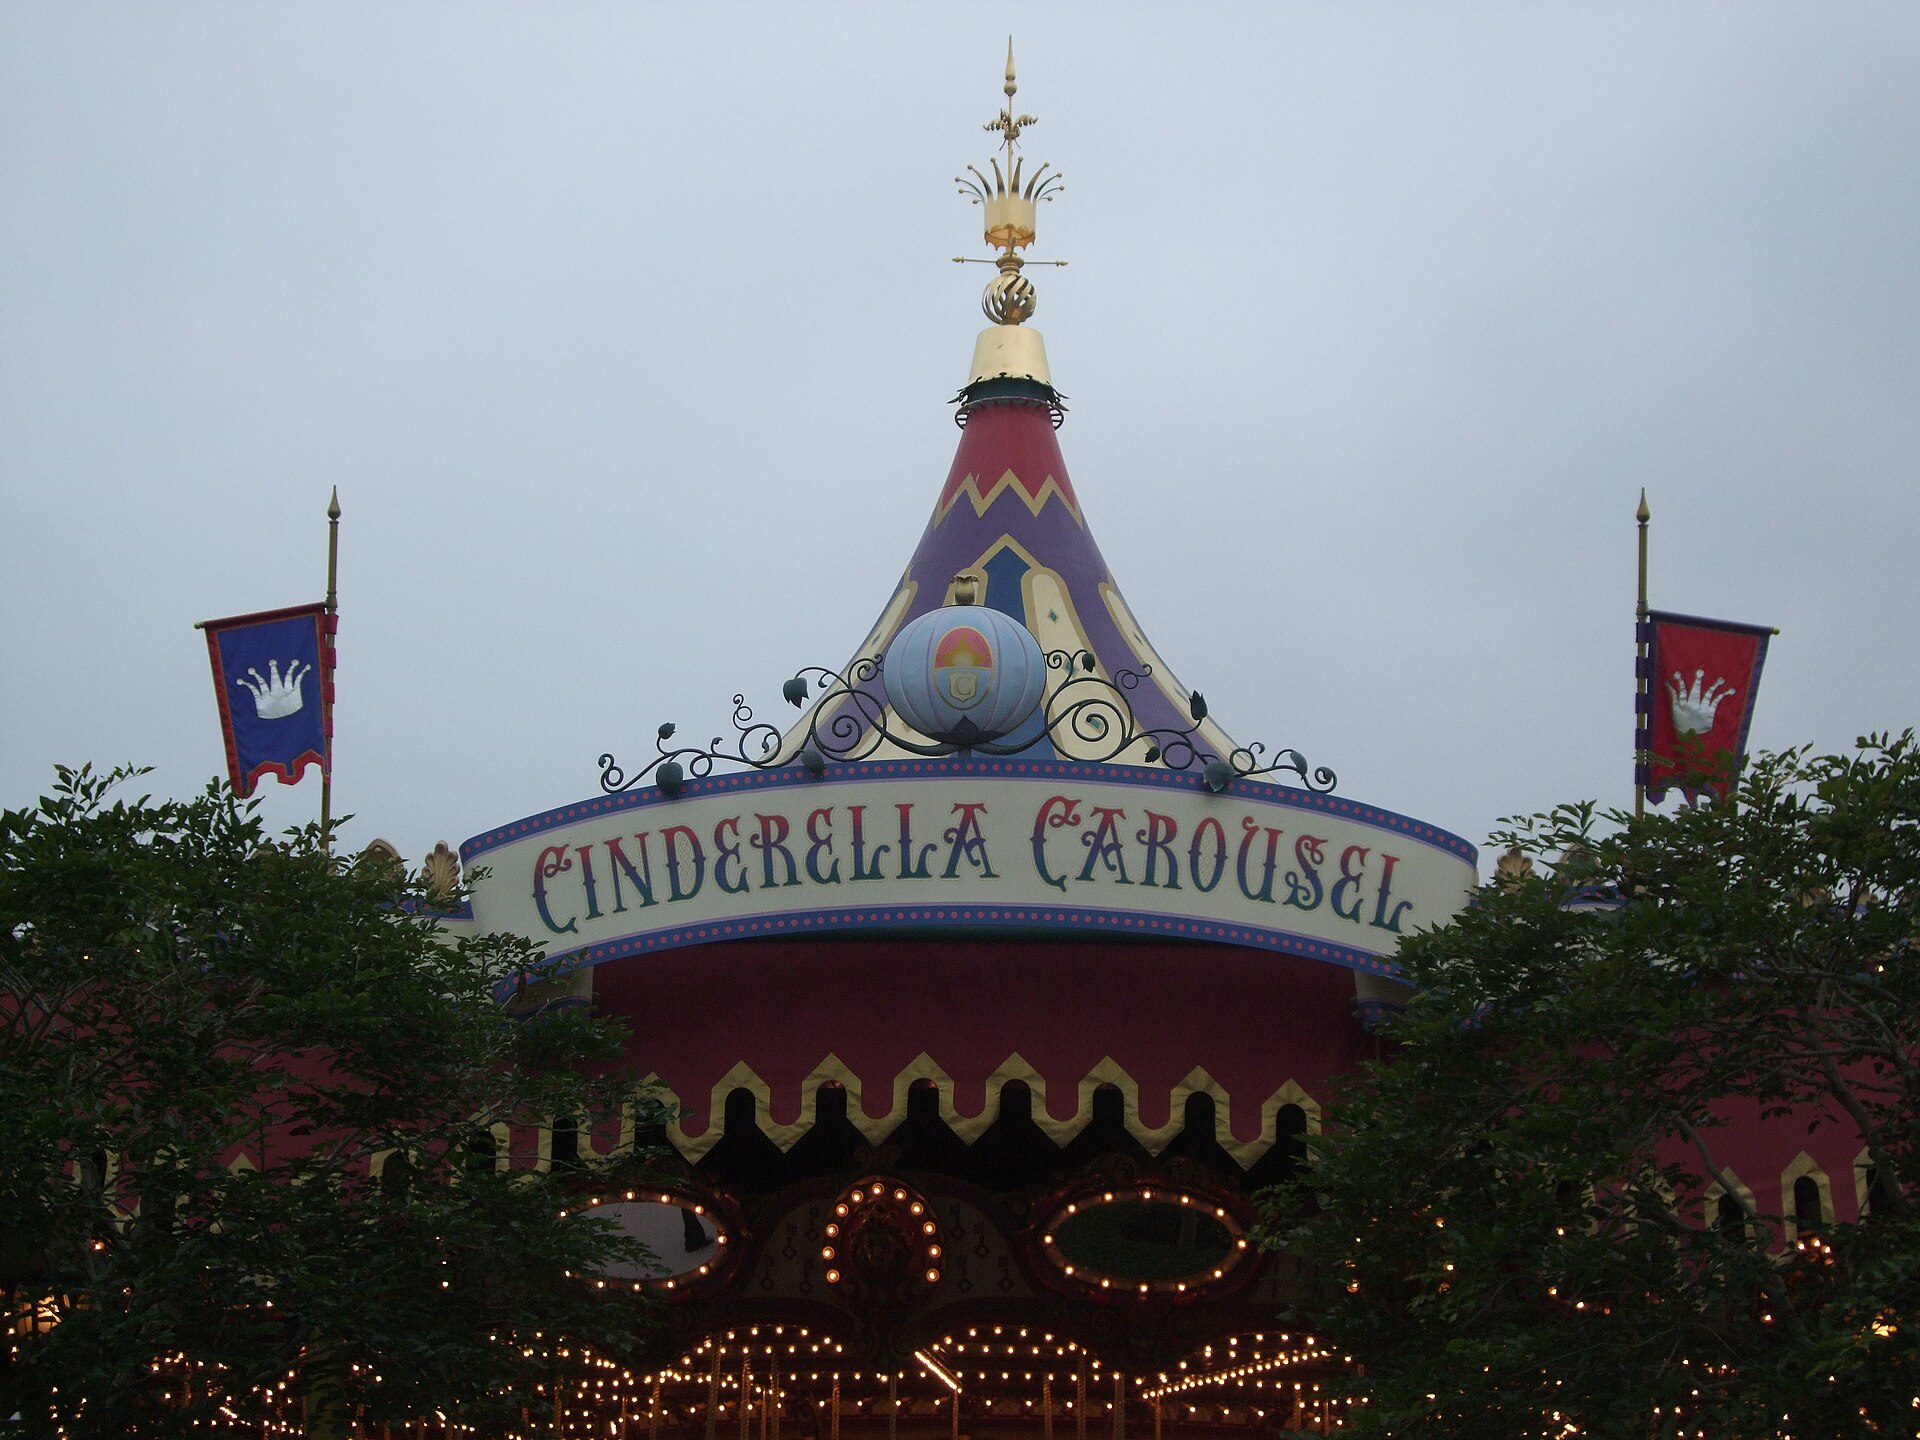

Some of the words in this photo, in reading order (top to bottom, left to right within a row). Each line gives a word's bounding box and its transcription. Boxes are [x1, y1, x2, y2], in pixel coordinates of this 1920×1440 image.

[954, 676, 972, 696] C
[531, 803, 999, 934] CINDERELLA
[1030, 795, 1413, 933] CAROUSEL
